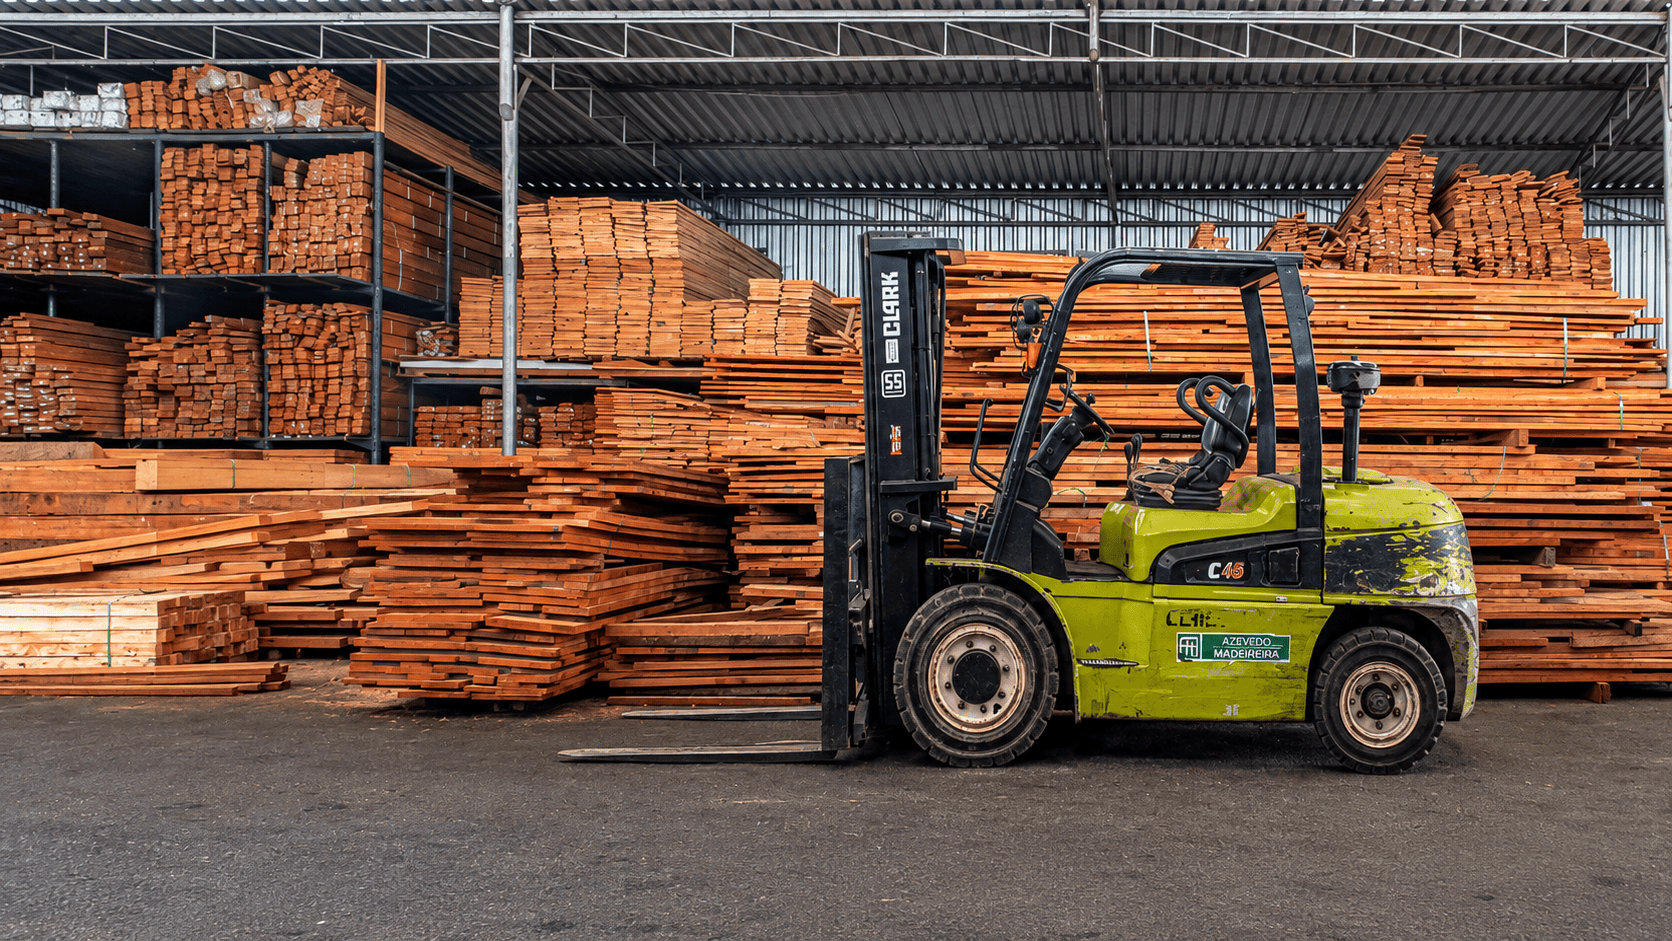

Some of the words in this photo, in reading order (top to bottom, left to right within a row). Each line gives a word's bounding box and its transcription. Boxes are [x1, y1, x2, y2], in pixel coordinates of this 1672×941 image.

[881, 271, 902, 337] CLARK
[1222, 636, 1272, 647] AZEVEDO
[1213, 649, 1280, 659] MADEIREIRA
